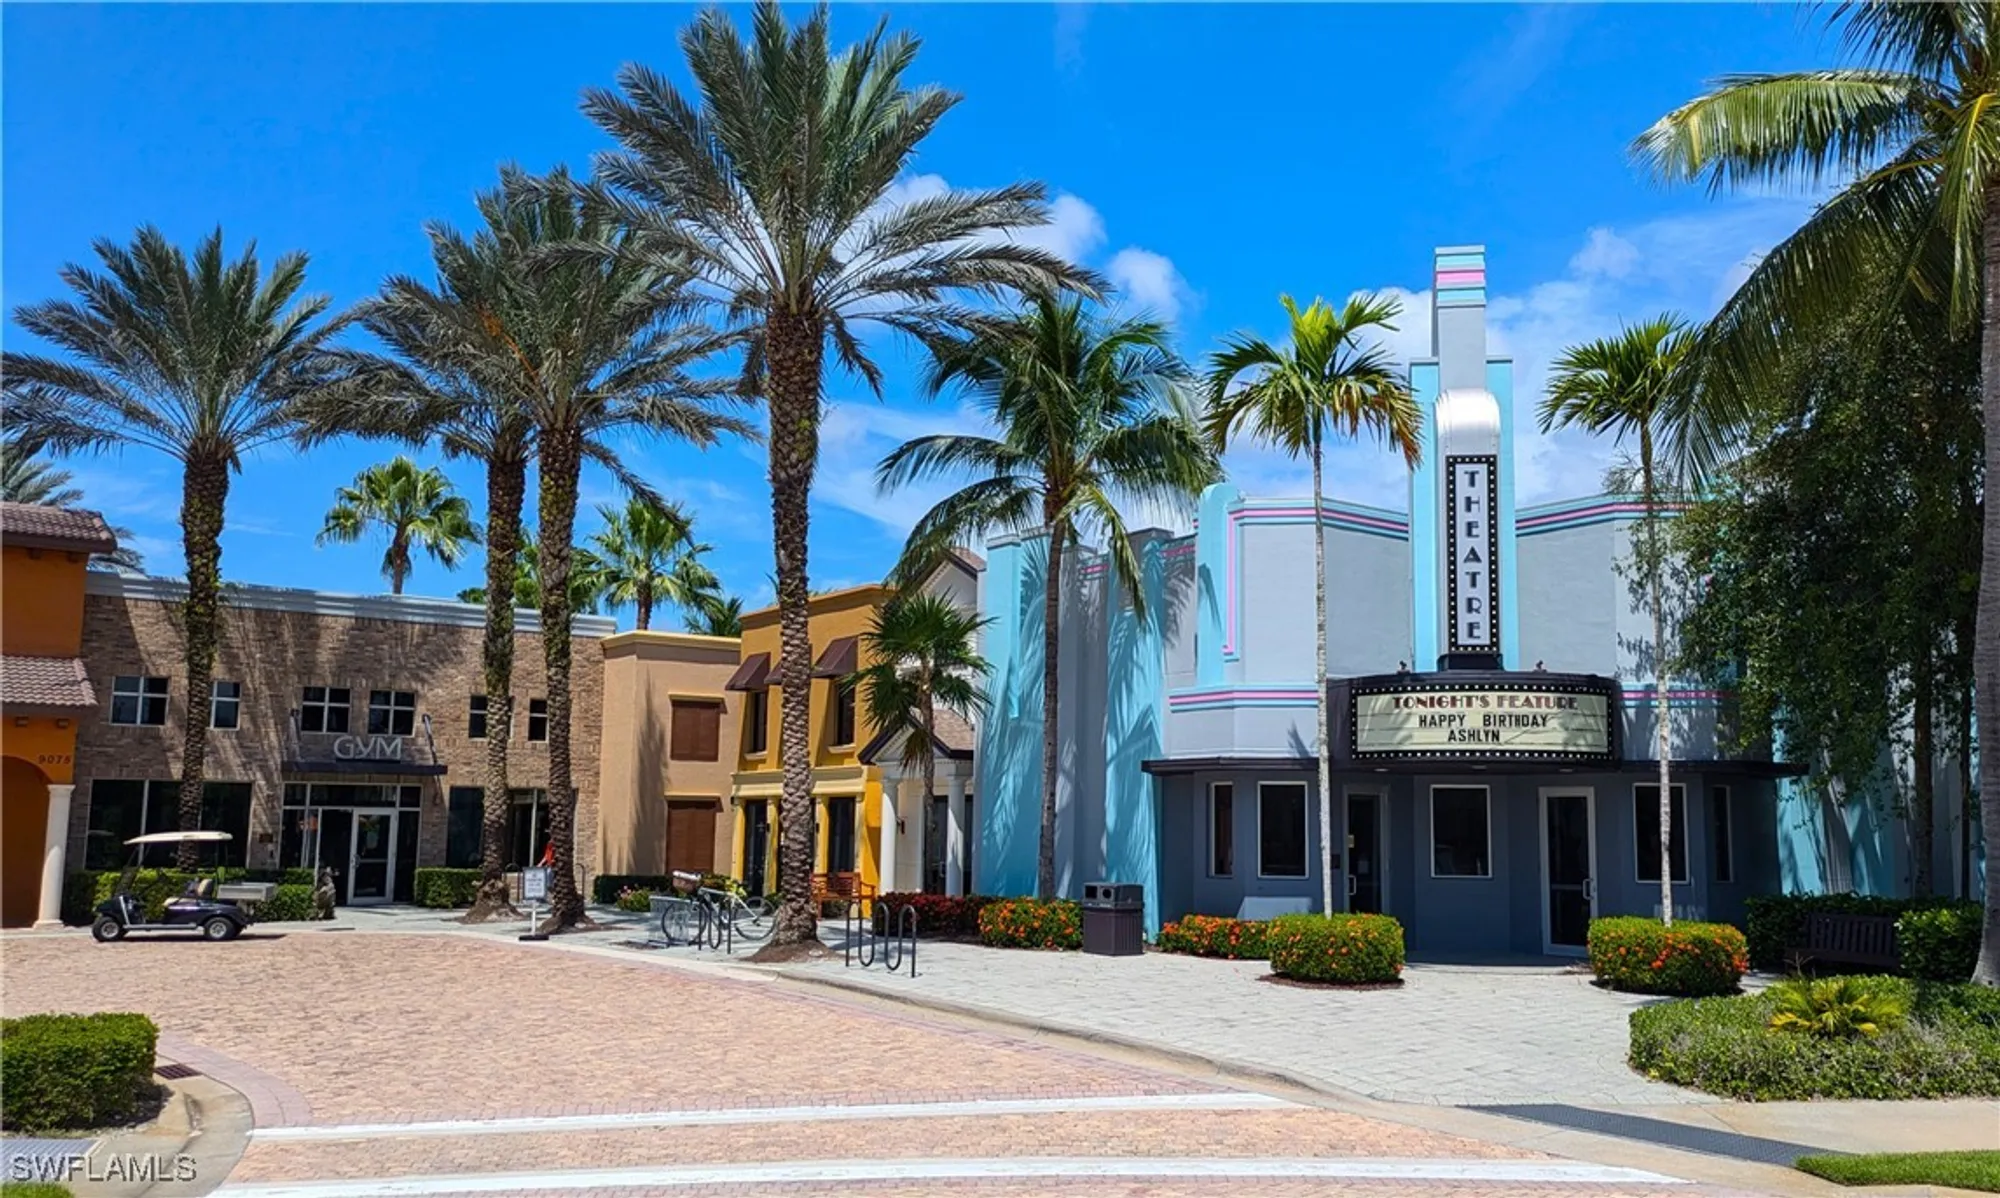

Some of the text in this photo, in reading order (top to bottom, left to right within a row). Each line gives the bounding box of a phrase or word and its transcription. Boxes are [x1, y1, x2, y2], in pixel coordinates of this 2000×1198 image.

[1463, 470, 1482, 639] THEATRE
[1392, 695, 1578, 710] TONIGHT'S FEATURE
[1419, 714, 1548, 728] HAPPY BIRTHDAY
[1447, 729, 1500, 742] ASHLYN
[333, 735, 403, 759] GYM
[38, 754, 71, 765] 9075
